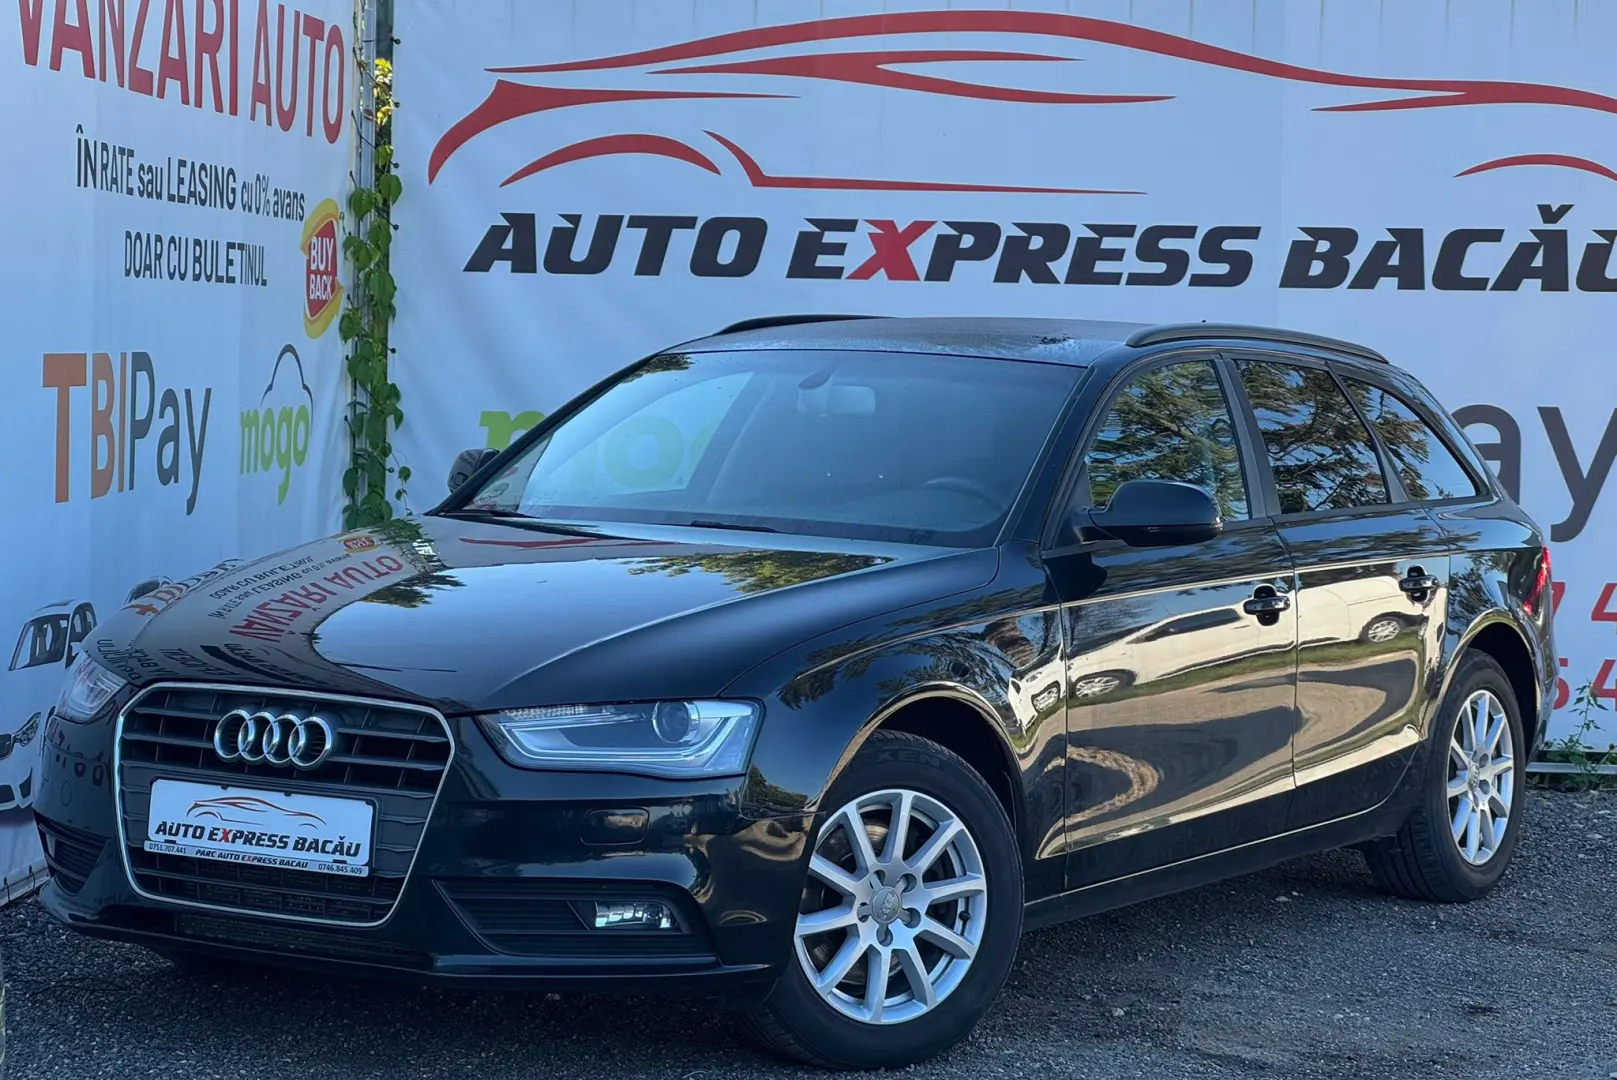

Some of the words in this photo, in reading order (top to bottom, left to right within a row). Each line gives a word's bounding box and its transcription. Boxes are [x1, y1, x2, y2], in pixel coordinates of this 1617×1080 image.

[250, 0, 345, 144] AUTO
[76, 124, 98, 190] ÎN
[100, 141, 135, 196] RATE
[137, 162, 163, 200] sau
[167, 156, 237, 211] LEASING
[273, 186, 306, 222] avans
[124, 230, 163, 280] DOAR
[166, 236, 190, 281] CU
[310, 236, 334, 271] BUY
[462, 212, 768, 278] AUTO
[785, 218, 1262, 288] EXPRESS
[309, 274, 332, 300] BACK
[240, 404, 310, 506] mogo
[149, 843, 186, 855] 0751.707.441
[155, 821, 205, 840] AUTO
[207, 827, 290, 849] EXPRESS
[292, 835, 361, 858] BACĂU
[195, 849, 217, 858] PARC
[217, 852, 240, 861] AUTO
[241, 854, 277, 865] EXPRESS
[317, 863, 362, 875] 0746.845.409
